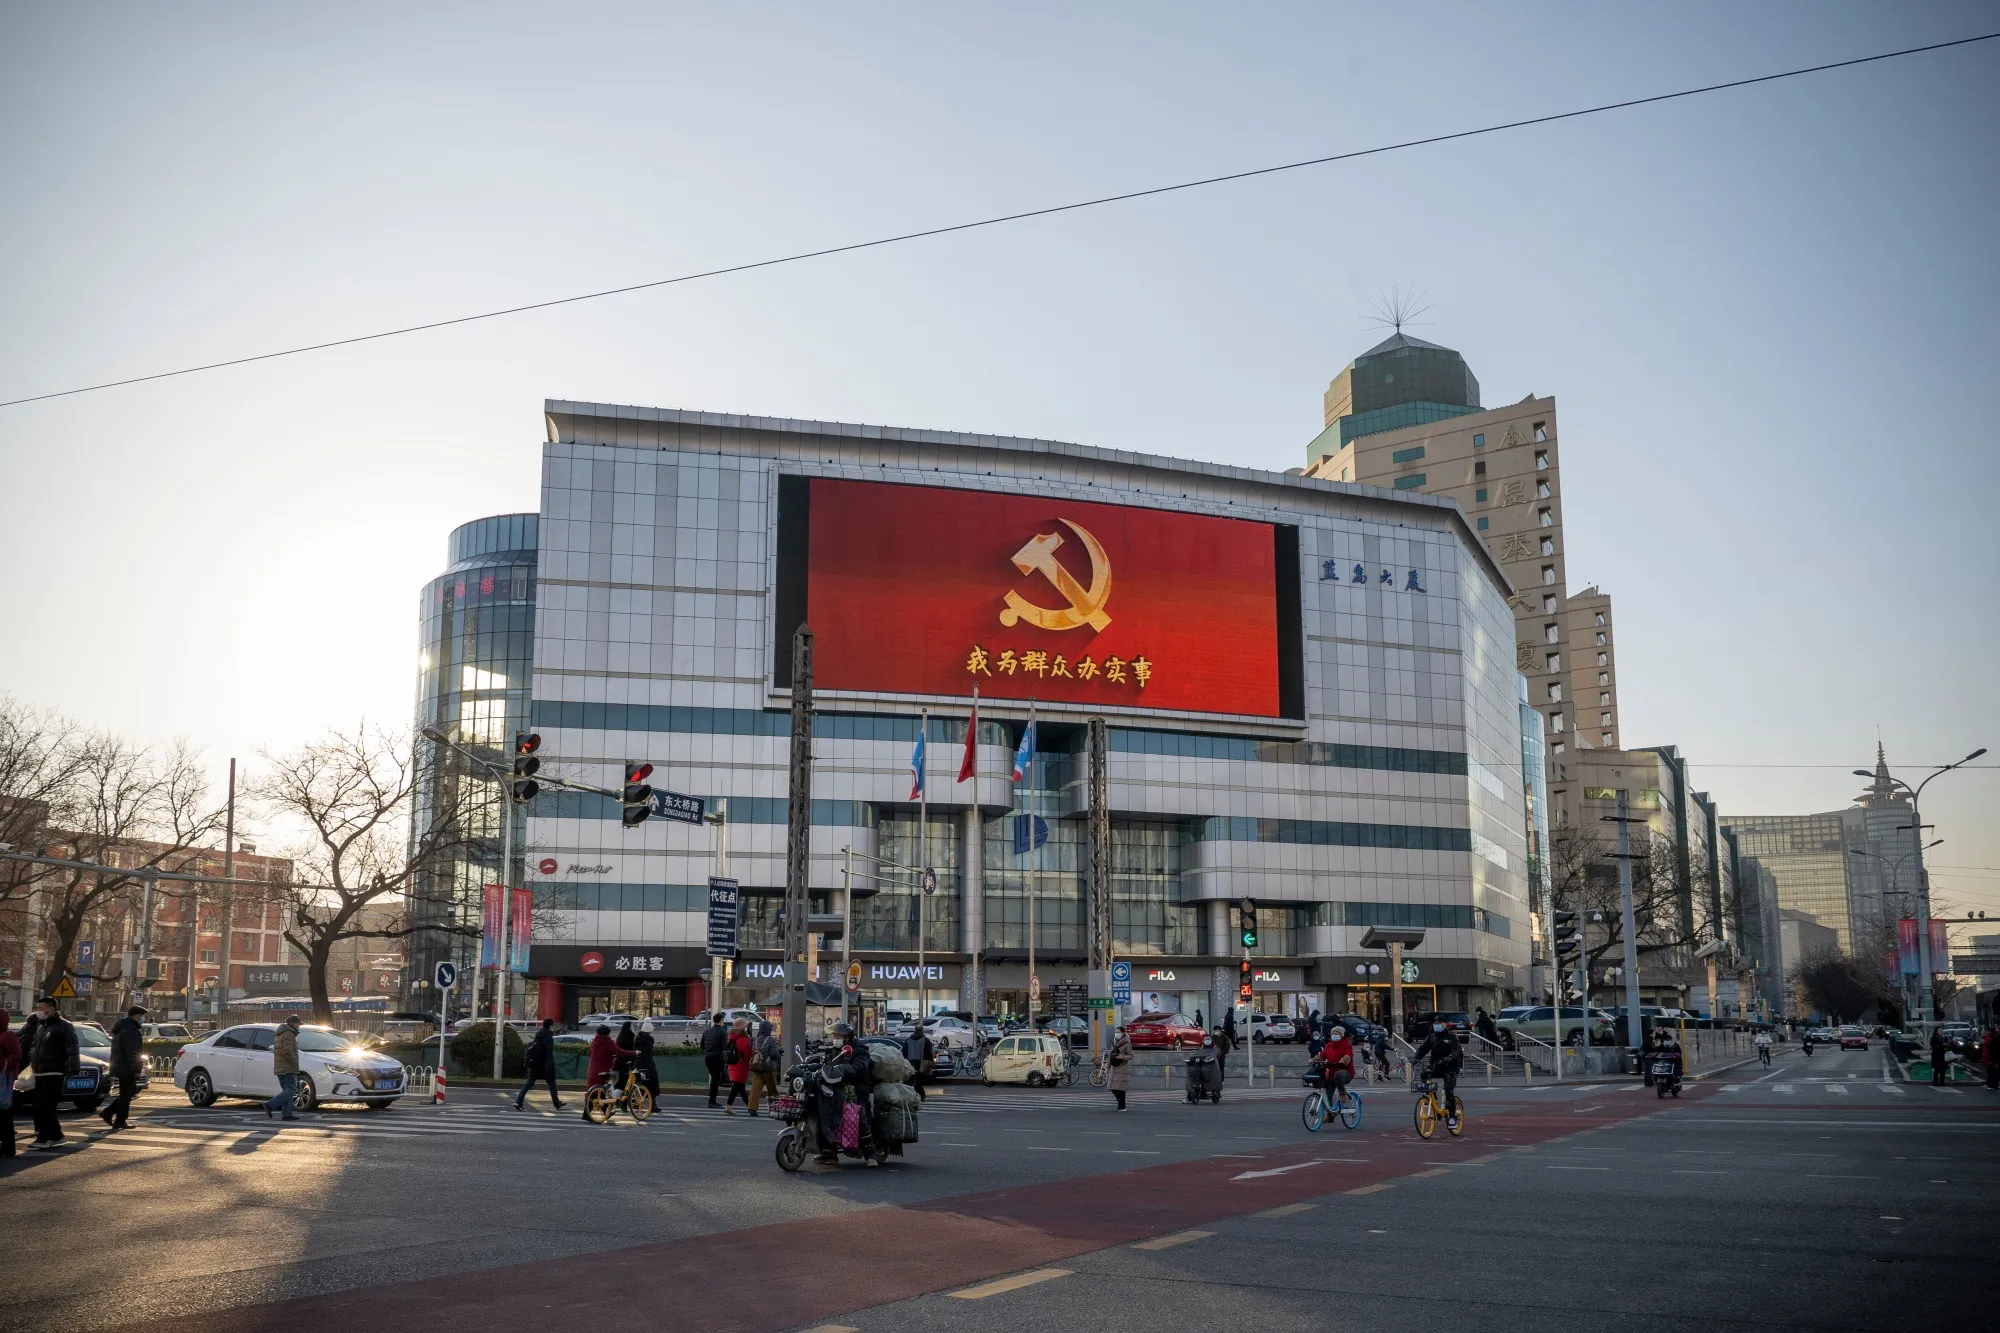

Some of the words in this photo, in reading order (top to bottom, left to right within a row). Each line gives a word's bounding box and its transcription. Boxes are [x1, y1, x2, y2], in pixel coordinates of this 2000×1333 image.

[966, 645, 1153, 688] 我为群众办实事
[664, 795, 700, 813] 东大桥路
[663, 807, 692, 820] DONGDAQIAO
[710, 890, 736, 904] 代征点
[615, 956, 664, 971] 必胜客
[745, 965, 820, 979] HUAI
[871, 966, 943, 980] HUAWEI
[1148, 970, 1176, 981] FILA
[1254, 971, 1281, 982] FILA
[1241, 985, 1252, 996] 20
